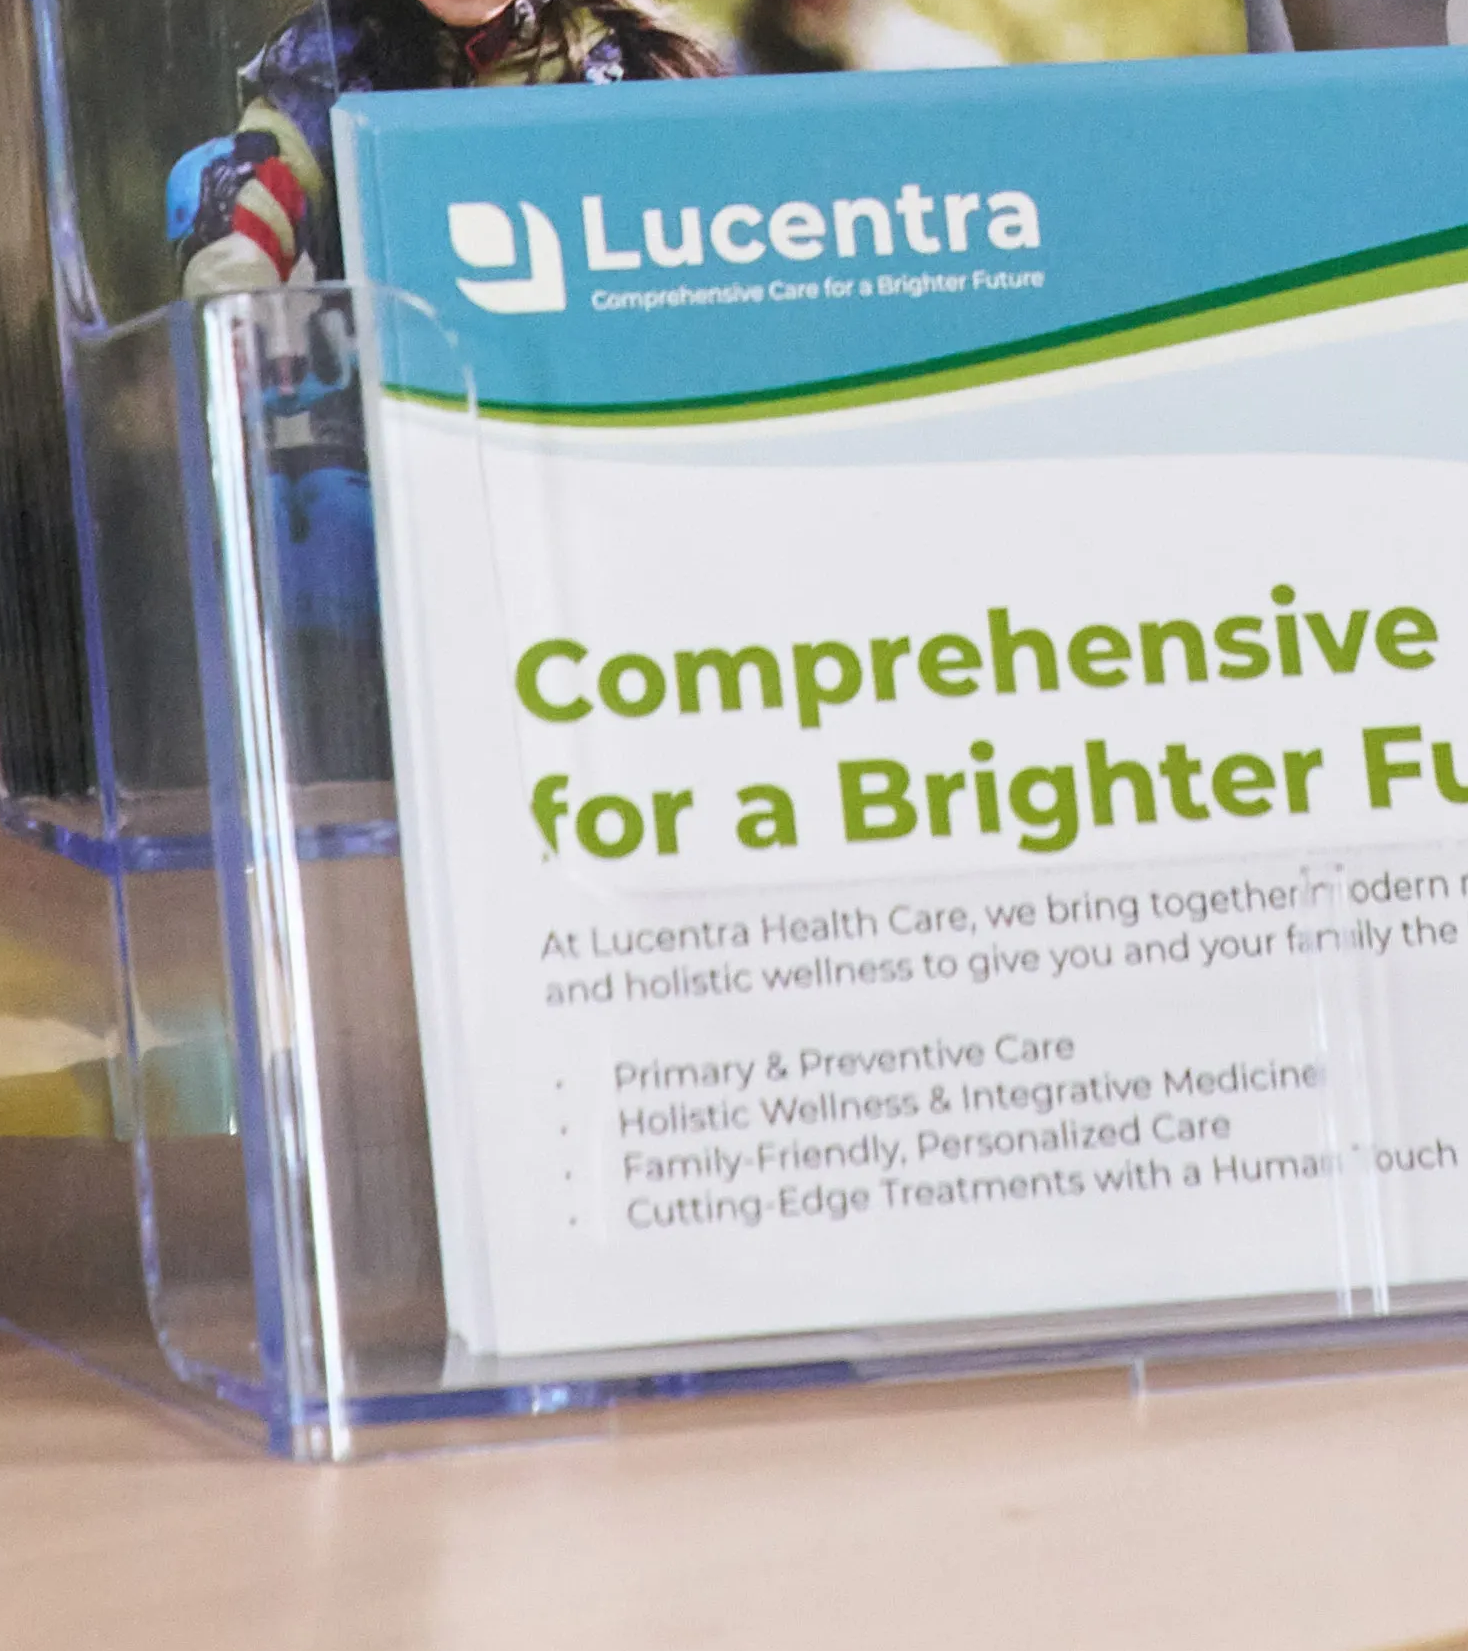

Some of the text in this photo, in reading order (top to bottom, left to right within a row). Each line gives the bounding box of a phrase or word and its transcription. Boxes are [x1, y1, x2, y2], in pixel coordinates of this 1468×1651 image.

[582, 184, 1040, 270] Lucentra
[591, 269, 1046, 312] Comprehensive Care for a Brighter Future
[515, 584, 1438, 729] Comprehensive
[531, 774, 693, 859] for
[736, 784, 797, 849] a
[838, 739, 1323, 853] Brighter
[541, 930, 579, 960] At
[592, 921, 749, 957] Lucentra
[761, 907, 877, 944] Health
[888, 904, 976, 935] Care,
[985, 903, 1036, 928] we
[1046, 892, 1139, 927] bring
[1150, 880, 1298, 922] together
[546, 972, 614, 1005] and
[625, 962, 752, 1000] holistic
[762, 956, 914, 991] wellness
[922, 953, 958, 979] to
[968, 943, 1040, 983] give
[1049, 944, 1112, 978] you
[1125, 932, 1189, 965] and
[1200, 933, 1275, 967] your
[1401, 915, 1457, 947] the
[615, 1033, 1074, 1091] Primary & Preventive Care
[619, 1061, 1318, 1137] Holistic Wellness & Integrative Medicine
[624, 1113, 1230, 1182] Family-Friendly, Personalized Care
[627, 1184, 870, 1228] Cutting-Edge
[881, 1169, 1085, 1207] Treatments
[1094, 1158, 1171, 1192] with
[1183, 1163, 1201, 1186] a
[1352, 1137, 1458, 1172] ouch
